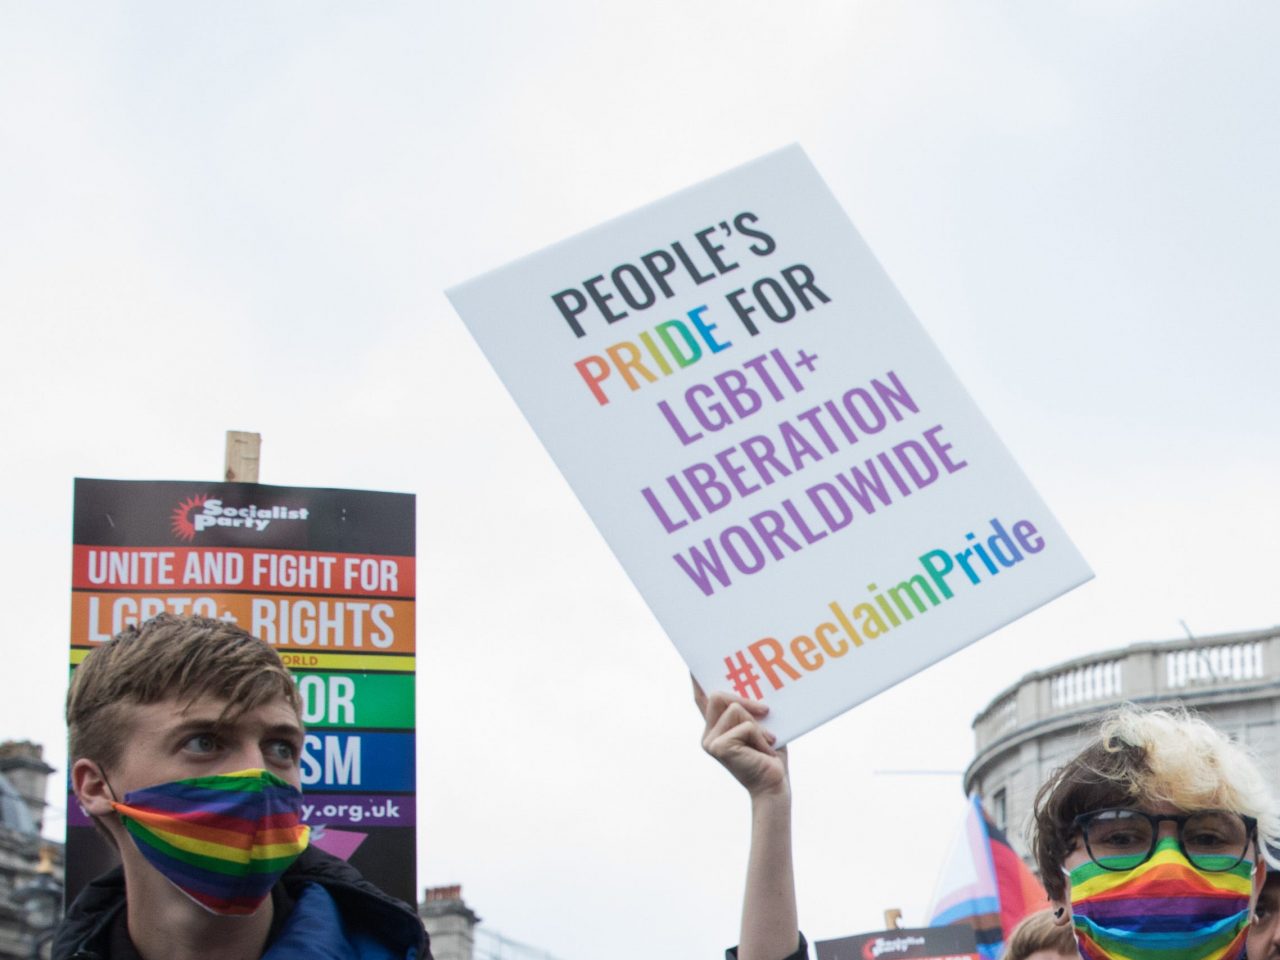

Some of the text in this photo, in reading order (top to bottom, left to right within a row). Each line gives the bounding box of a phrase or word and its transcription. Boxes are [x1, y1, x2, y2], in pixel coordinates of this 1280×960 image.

[550, 211, 777, 339] PEOPLE'S
[573, 261, 832, 406] PRIDE FOR
[640, 369, 920, 535] LIBERATION
[657, 347, 820, 446] LGBTI+
[203, 499, 310, 520] Socialist
[671, 424, 968, 598] WORLDWIDE
[88, 550, 398, 592] UNITE AND FIGHT FOR
[251, 598, 395, 648] RIGHTS
[724, 516, 1046, 702] #ReclaimPride
[279, 654, 318, 666] ORLD
